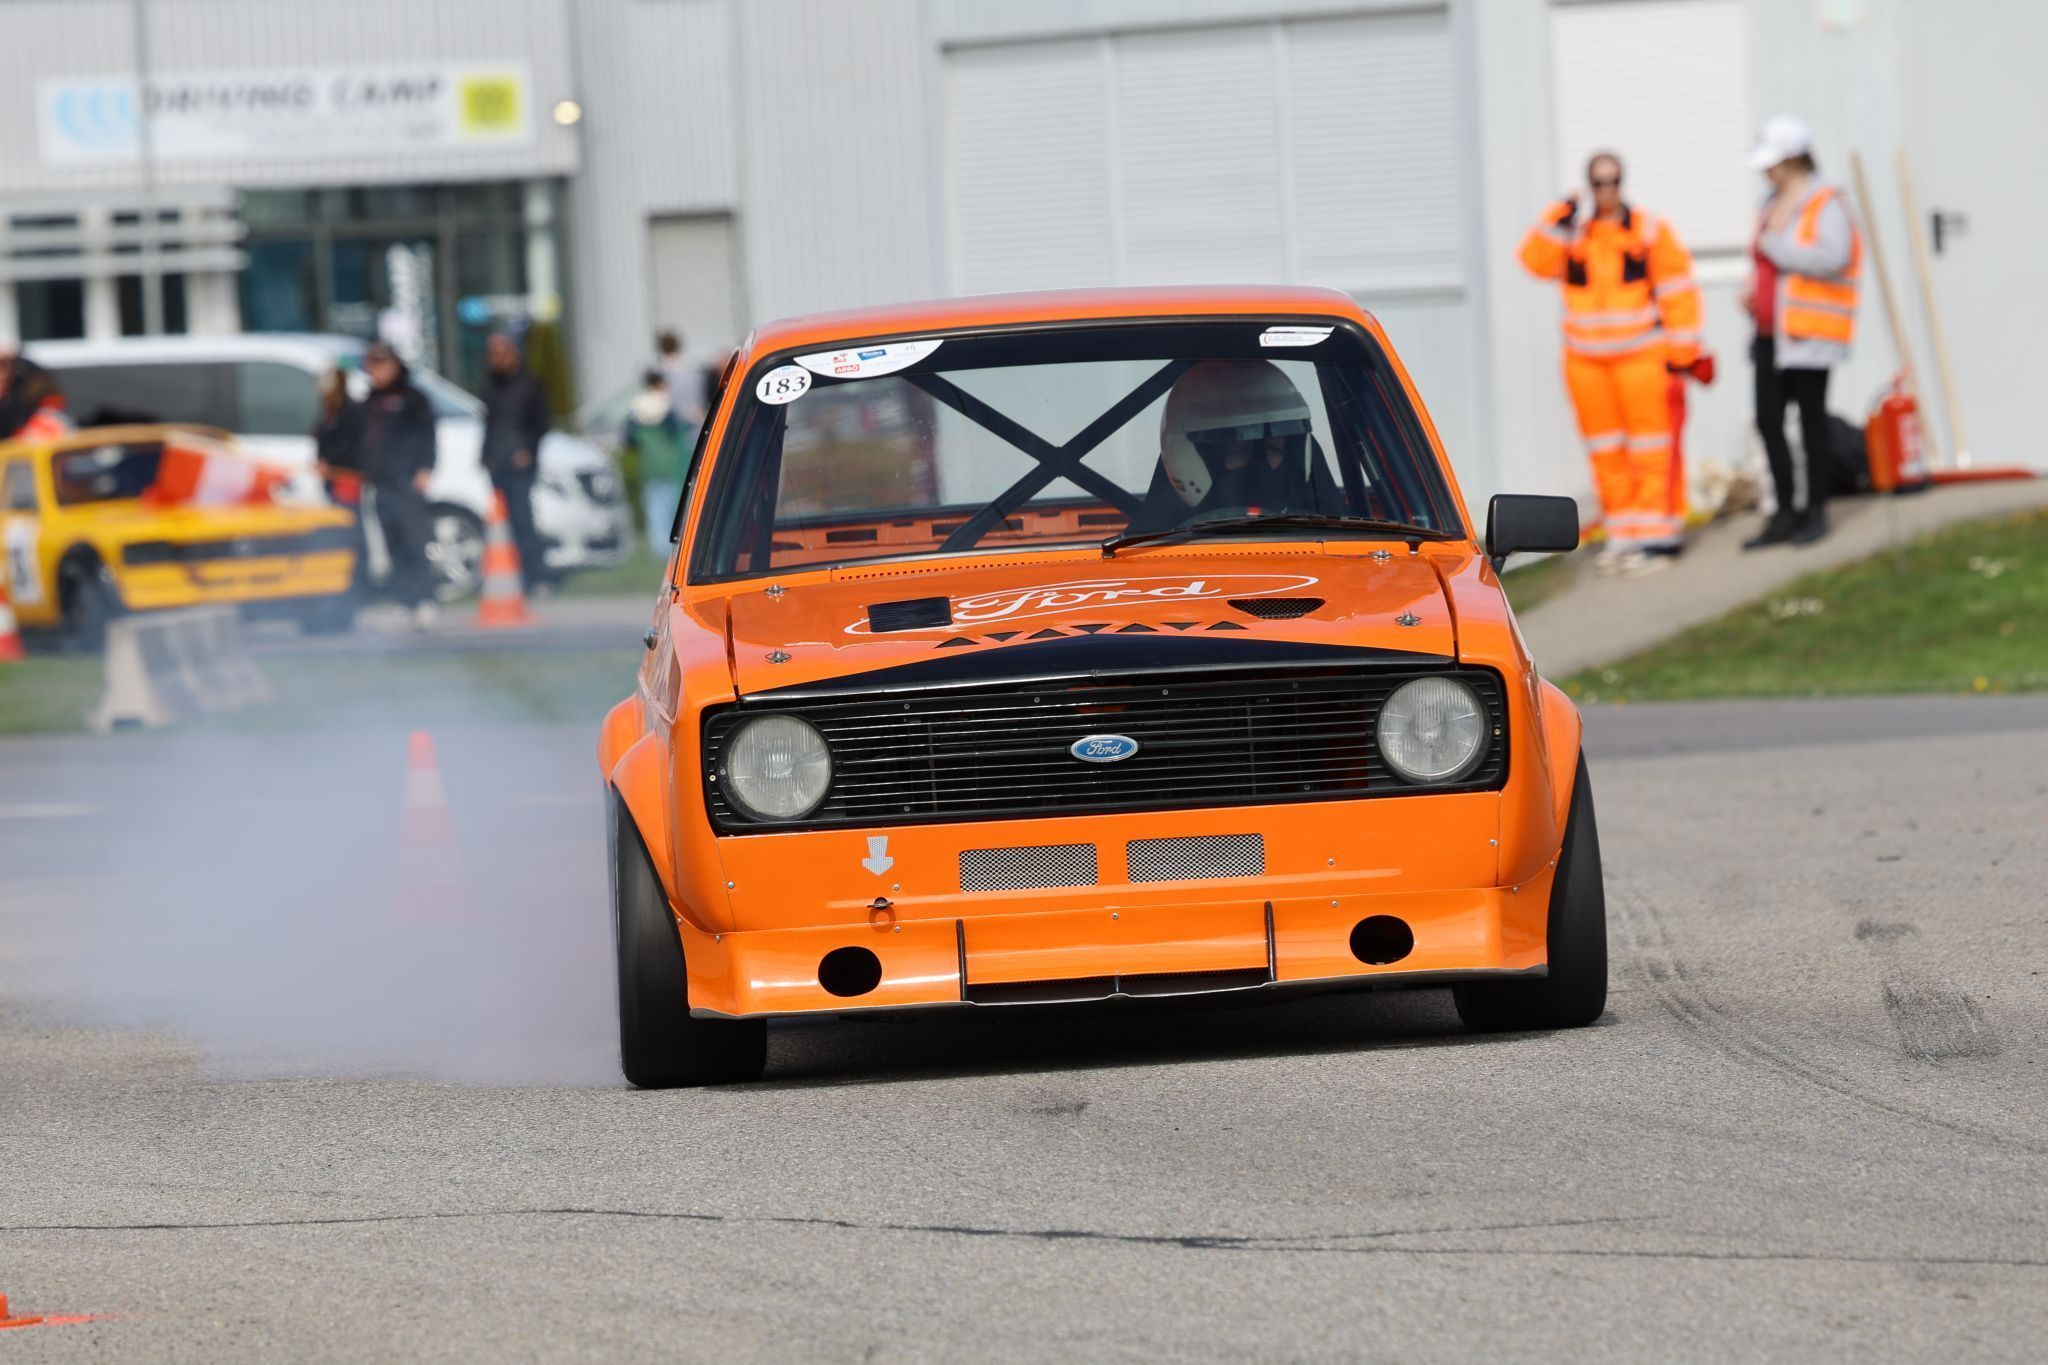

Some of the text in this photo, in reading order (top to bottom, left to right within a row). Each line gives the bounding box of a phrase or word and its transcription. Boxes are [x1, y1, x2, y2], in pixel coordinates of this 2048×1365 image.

[763, 376, 806, 397] 183
[953, 581, 1221, 620] Ford
[1087, 740, 1121, 755] Ford
